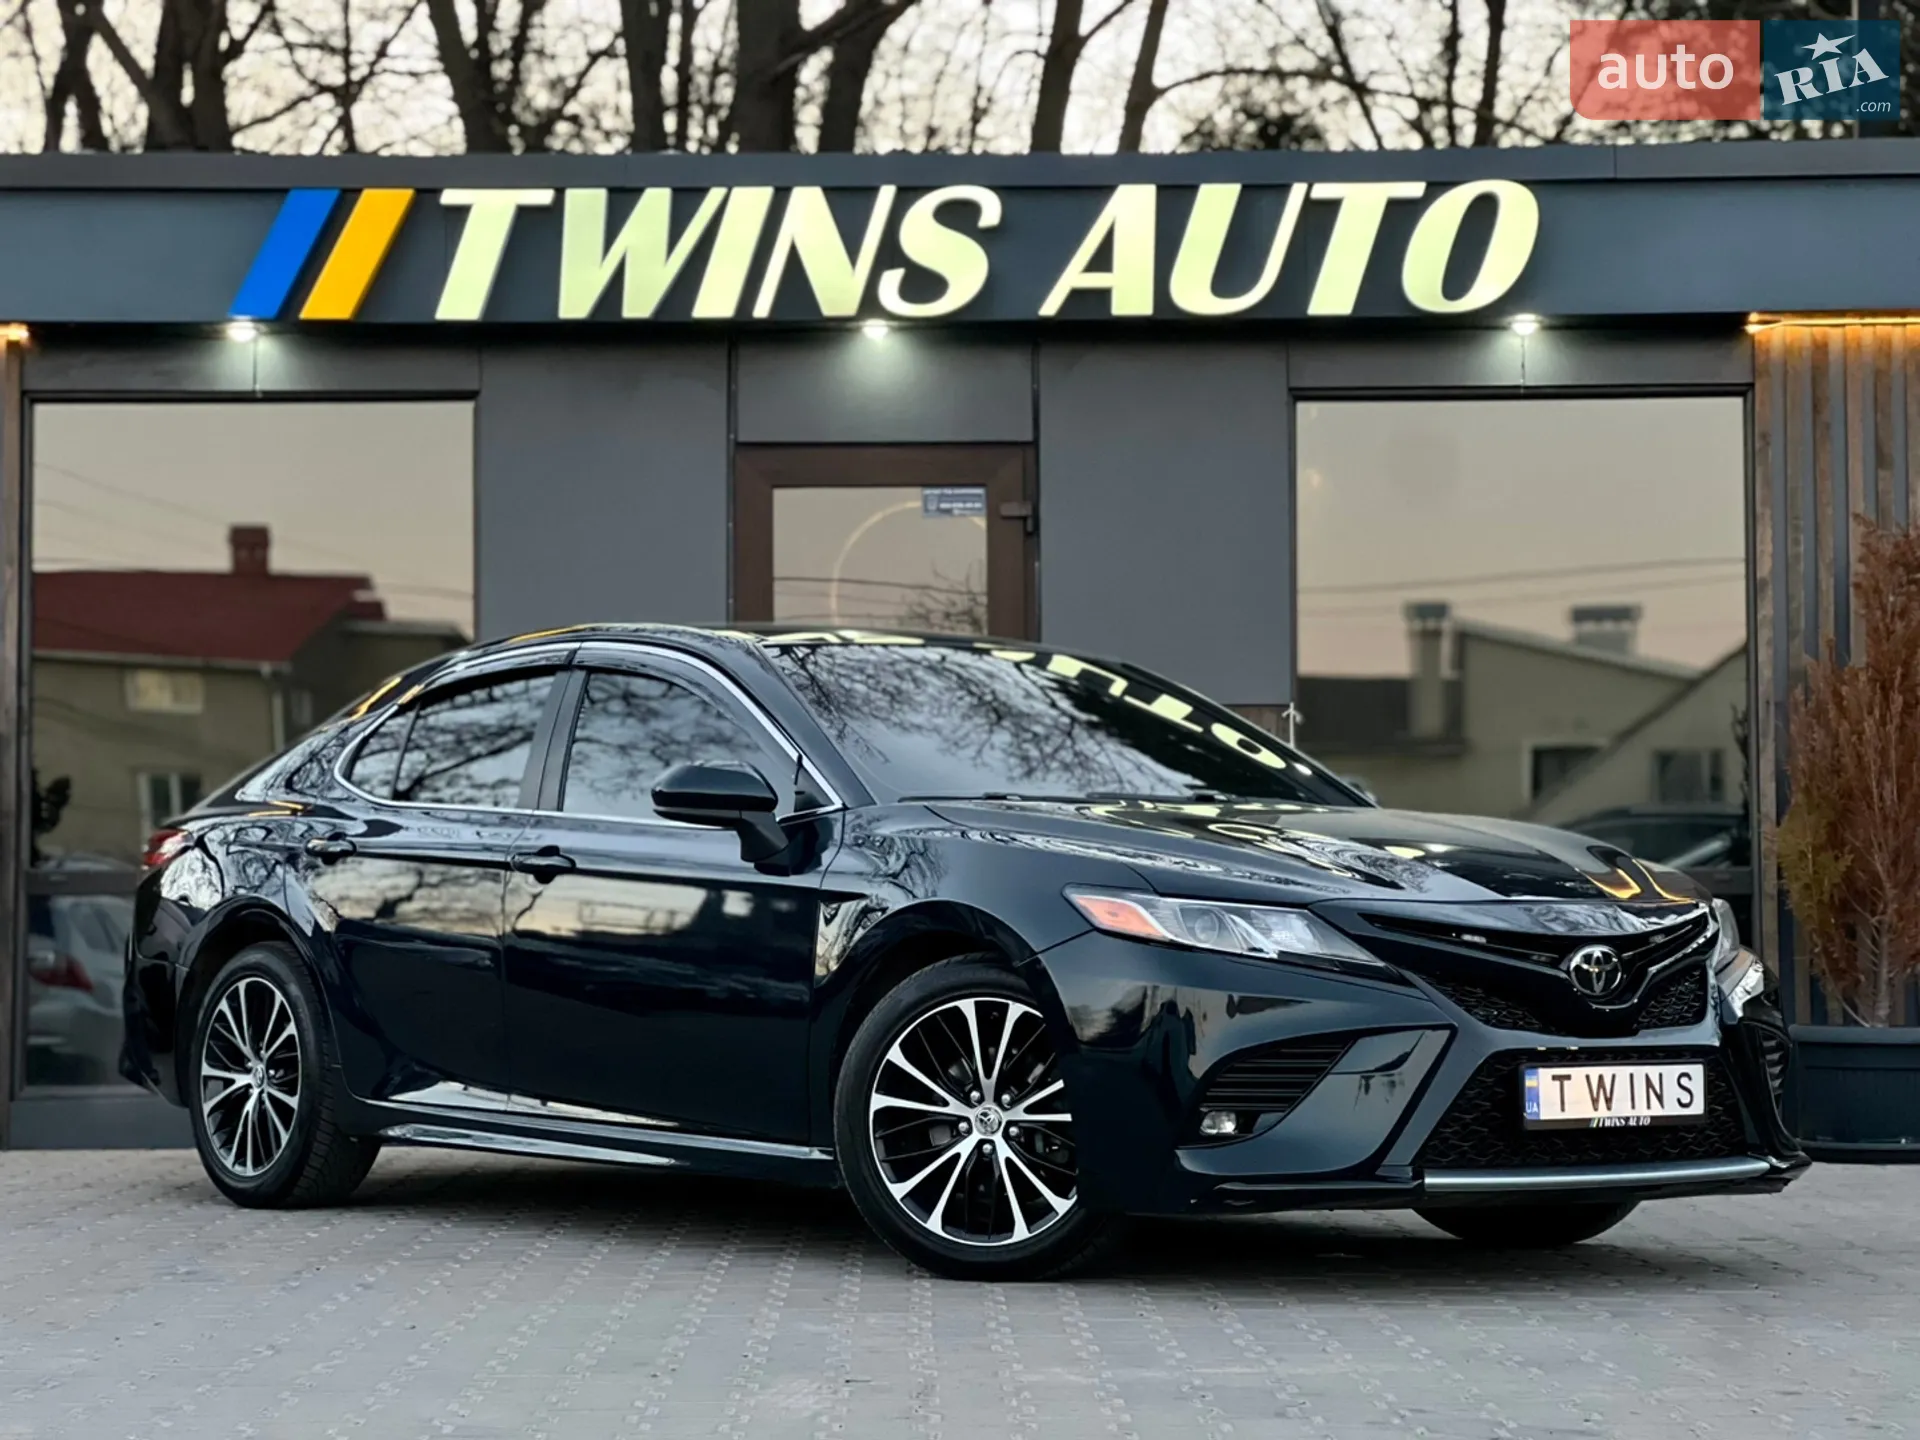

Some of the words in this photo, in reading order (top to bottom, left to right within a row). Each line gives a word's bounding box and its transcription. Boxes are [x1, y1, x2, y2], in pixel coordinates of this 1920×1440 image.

[434, 184, 1002, 322] TWINS
[1037, 179, 1540, 318] AUTO
[1525, 1101, 1539, 1114] UA
